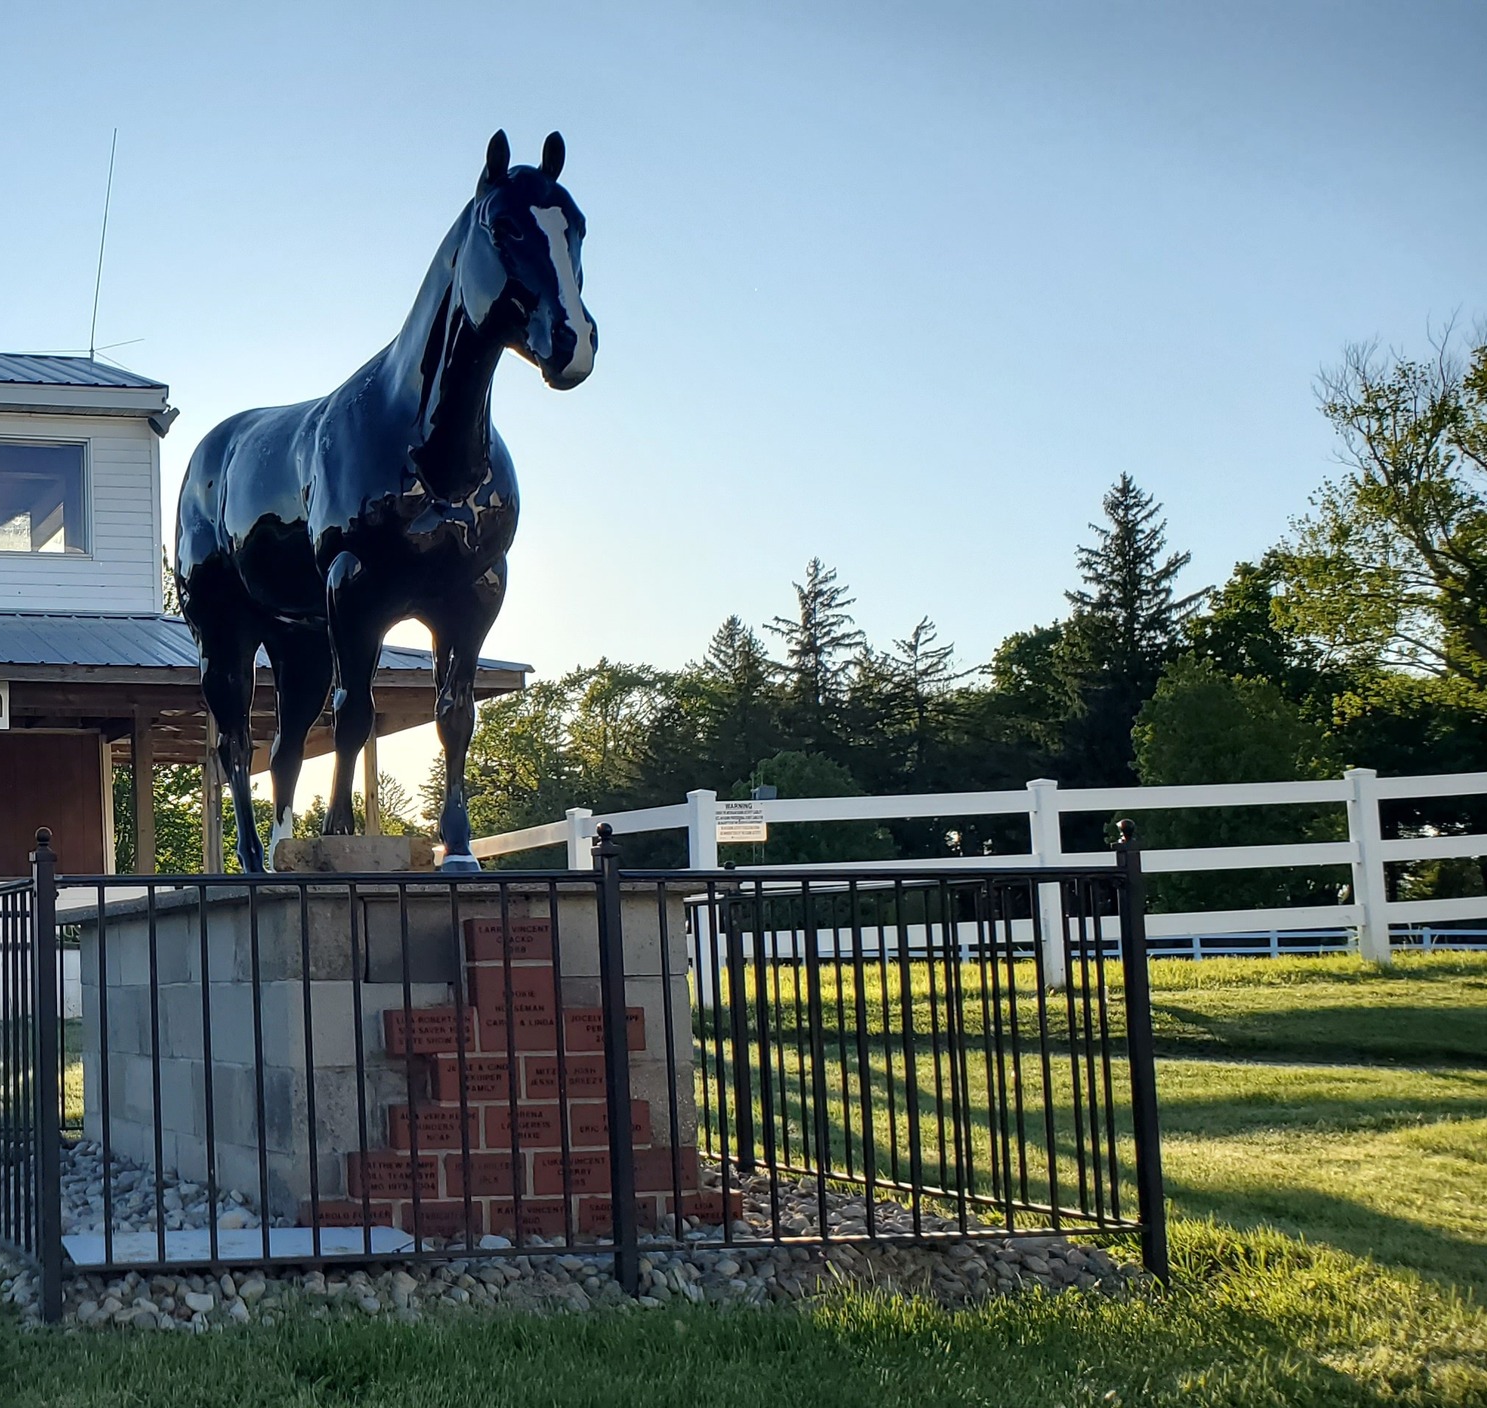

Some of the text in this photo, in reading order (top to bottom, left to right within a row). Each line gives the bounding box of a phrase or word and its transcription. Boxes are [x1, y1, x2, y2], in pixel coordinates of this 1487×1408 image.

[478, 924, 550, 934] LARR VINCENT
[487, 1063, 512, 1071] CIND
